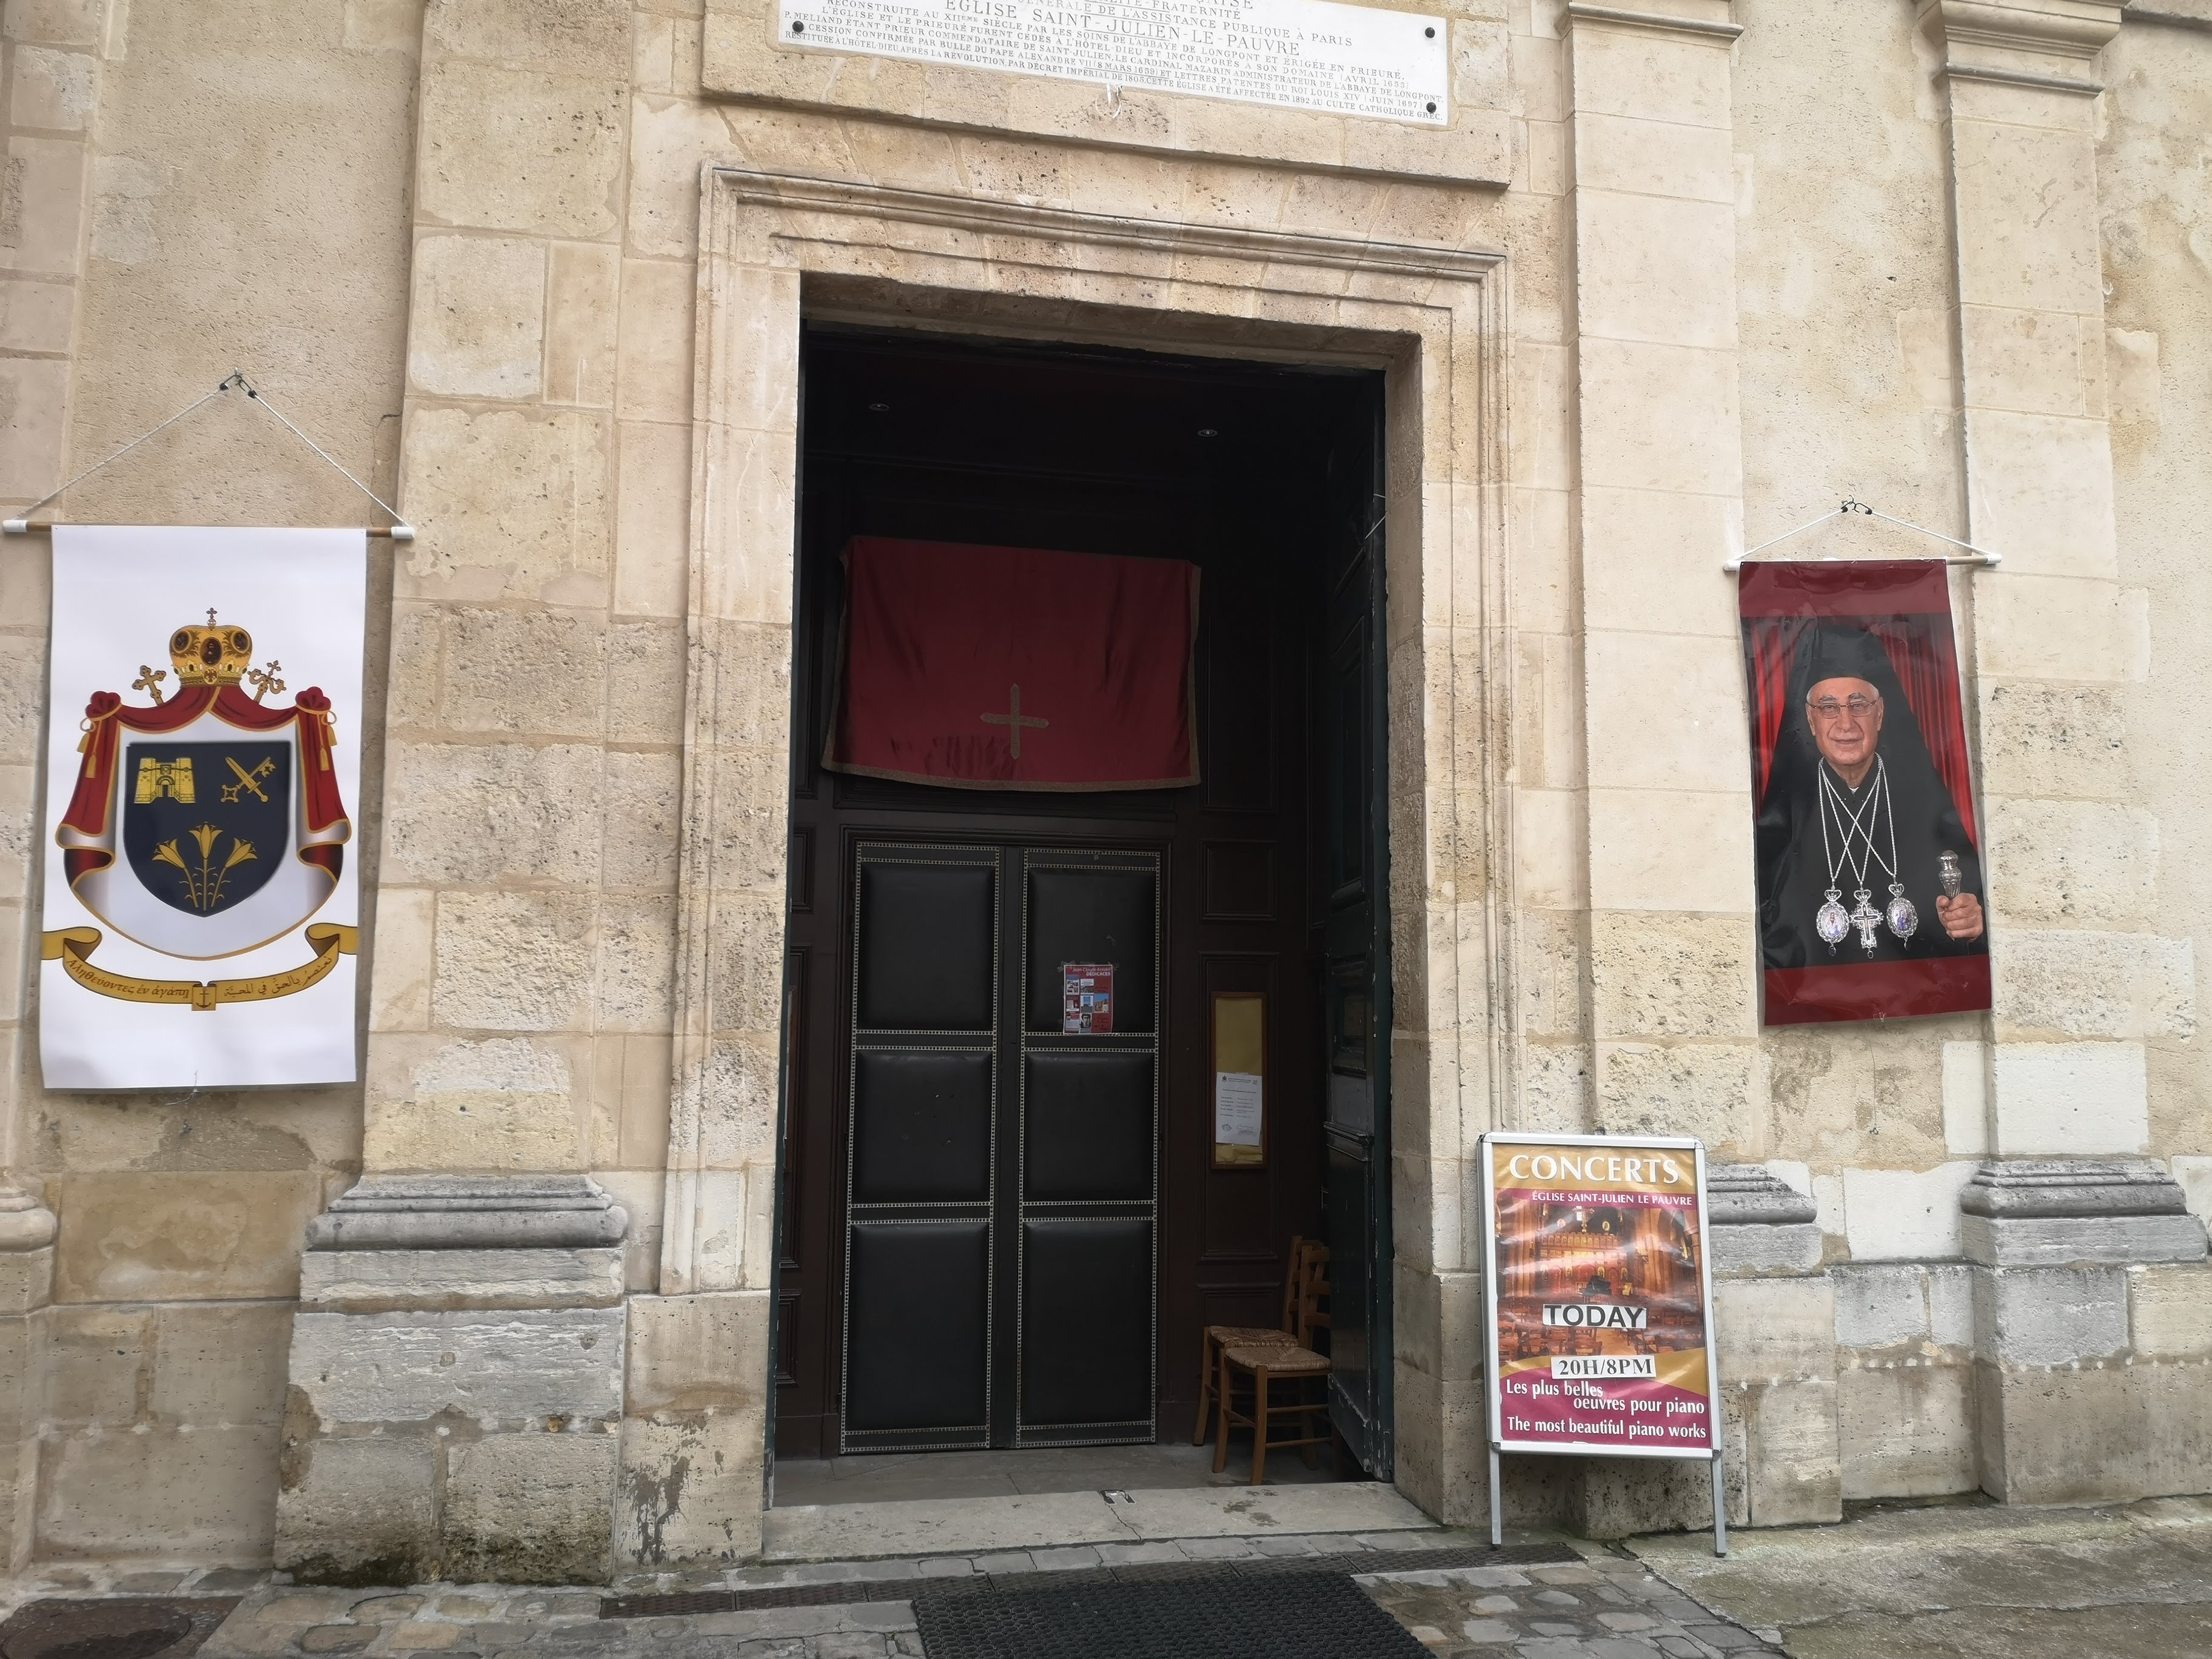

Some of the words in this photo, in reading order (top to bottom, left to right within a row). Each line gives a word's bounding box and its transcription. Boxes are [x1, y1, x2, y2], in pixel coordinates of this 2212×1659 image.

[1098, 4, 1116, 15] DE
[1122, 7, 1216, 28] L'ASSISTANCE
[1222, 21, 1290, 38] PUBLIQUE
[1296, 28, 1304, 40] À
[1311, 33, 1352, 47] PARIS
[822, 5, 874, 19] L'ÉGLISE
[879, 13, 893, 22] ET
[897, 16, 911, 25] LE
[916, 18, 967, 32] PRIEURÉ
[970, 25, 1013, 38] FURENT
[1017, 30, 1051, 43] CÉDÉS
[1056, 35, 1062, 44] À
[1067, 38, 1142, 55] L'HÔTEL-DIEU
[1148, 49, 1161, 57] ET
[1167, 51, 1240, 67] INCORPORÉS
[1245, 59, 1252, 69] À
[1256, 63, 1277, 72] SON
[1282, 66, 1334, 80] DOMAINE
[1340, 74, 1379, 87] (AVRIL
[1383, 79, 1409, 90] 1655)
[845, 16, 881, 30] ÉTANT
[885, 24, 925, 36] PRIEUR
[928, 29, 1020, 48] COMMENDATAIRE
[1024, 42, 1036, 50] DE
[1115, 53, 1128, 62] LE
[1130, 55, 1182, 69] CARDINAL
[1185, 62, 1231, 75] MAZARIN
[1233, 69, 1317, 87] ADMINISTRATEUR
[1320, 80, 1332, 89] DE
[1335, 82, 1376, 94] L'ABBAYE
[1380, 88, 1392, 96] DE
[923, 10, 939, 19] AU
[983, 17, 1022, 30] SIÈCLE
[1027, 24, 1047, 33] PAR
[1052, 27, 1072, 36] LES
[1076, 30, 1109, 41] SOINS
[1113, 35, 1126, 43] DE
[1129, 37, 1177, 50] L'ABBAYE
[1182, 44, 1196, 52] DE
[1201, 46, 1259, 61] LONGPONT
[1265, 55, 1278, 63] ET
[1283, 55, 1326, 69] ÉRIGÉE
[1330, 63, 1344, 72] EN
[1350, 65, 1405, 79] PRIEURÉ.
[808, 23, 851, 36] CESSION
[856, 29, 914, 44] CONFIRMÉE
[918, 37, 936, 46] PAR
[940, 40, 971, 51] BULLE
[974, 44, 987, 53] DU
[990, 46, 1014, 56] PAPE
[1017, 50, 1076, 64] ALEXANDRE
[1078, 58, 1091, 66] VII
[1105, 61, 1132, 72] MARS
[1134, 65, 1158, 75] 1659)
[1161, 68, 1171, 76] ET
[1174, 70, 1217, 82] LETTRES
[1221, 76, 1271, 89] PATENTES
[1275, 82, 1288, 92] DU
[1291, 85, 1307, 94] ROI
[1310, 87, 1339, 98] LOUIS
[1343, 92, 1360, 101] XIV
[1509, 1155, 1679, 1184] CONCERTS
[1532, 1190, 1565, 1202] ÉGLISE
[1567, 1193, 1634, 1204] SAINT-JULIEN
[1638, 1195, 1649, 1204] LE
[1652, 1195, 1692, 1205] PAUVRE
[1544, 1304, 1644, 1328] TODAY
[1558, 1358, 1653, 1375] 20H/8PM
[1506, 1379, 1527, 1395] Les
[1532, 1379, 1560, 1399] plus
[1564, 1381, 1603, 1397] belles
[1574, 1398, 1626, 1411] oeuvres
[1630, 1400, 1662, 1416] pour
[1666, 1397, 1705, 1417] piano
[1507, 1416, 1530, 1432] The
[1535, 1419, 1566, 1433] most
[1569, 1418, 1624, 1435] beautiful
[1629, 1421, 1664, 1439] piano
[1668, 1423, 1706, 1438] works
